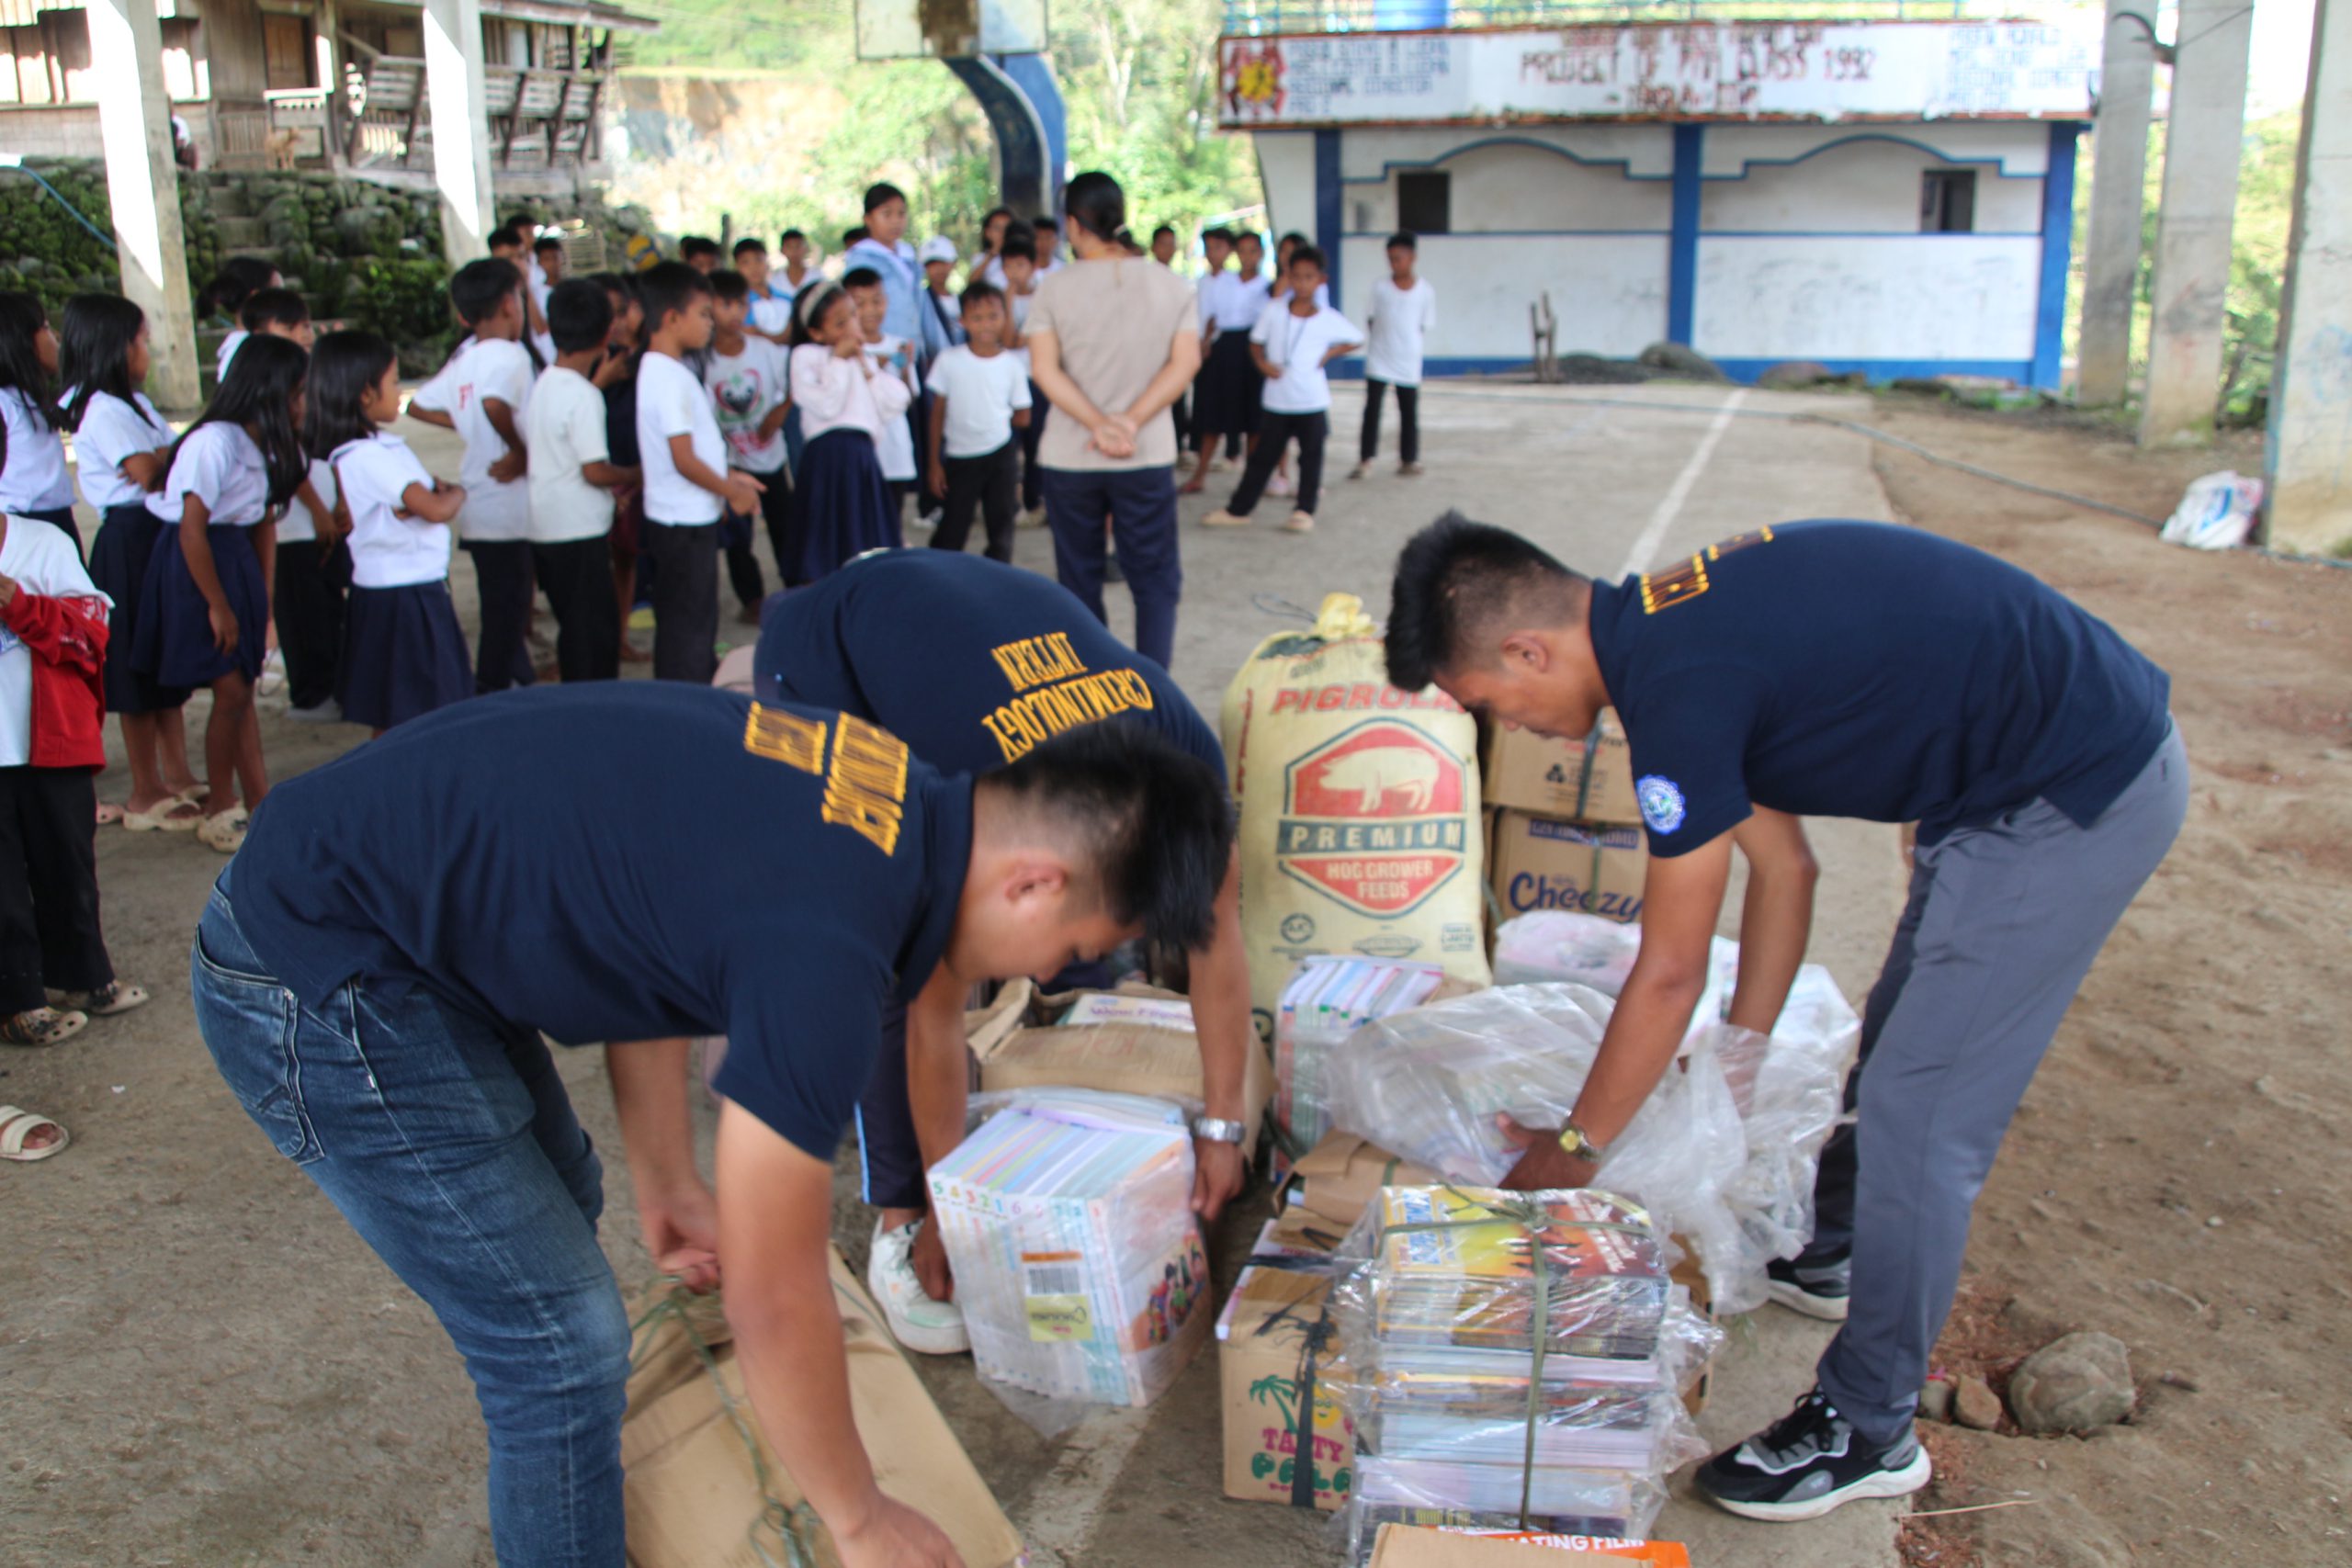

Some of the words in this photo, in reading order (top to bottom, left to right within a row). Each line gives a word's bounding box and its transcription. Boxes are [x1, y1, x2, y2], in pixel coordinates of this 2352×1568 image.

[1521, 50, 1621, 85] PROJECT
[1823, 48, 1874, 80] 1992
[990, 631, 1089, 693] INTERN
[1270, 682, 1467, 715] PIGROLA
[980, 667, 1154, 764] CRIMINOLOGY
[1289, 821, 1462, 851] PREMIUM
[1365, 859, 1433, 879] GROWER
[1357, 882, 1409, 899] FEEDS
[933, 1181, 944, 1194] 5
[967, 1190, 976, 1203] 3
[981, 1193, 990, 1209] 2
[995, 1199, 1003, 1213] 1
[1012, 1201, 1022, 1215] 6
[1261, 1427, 1345, 1463] TATY
